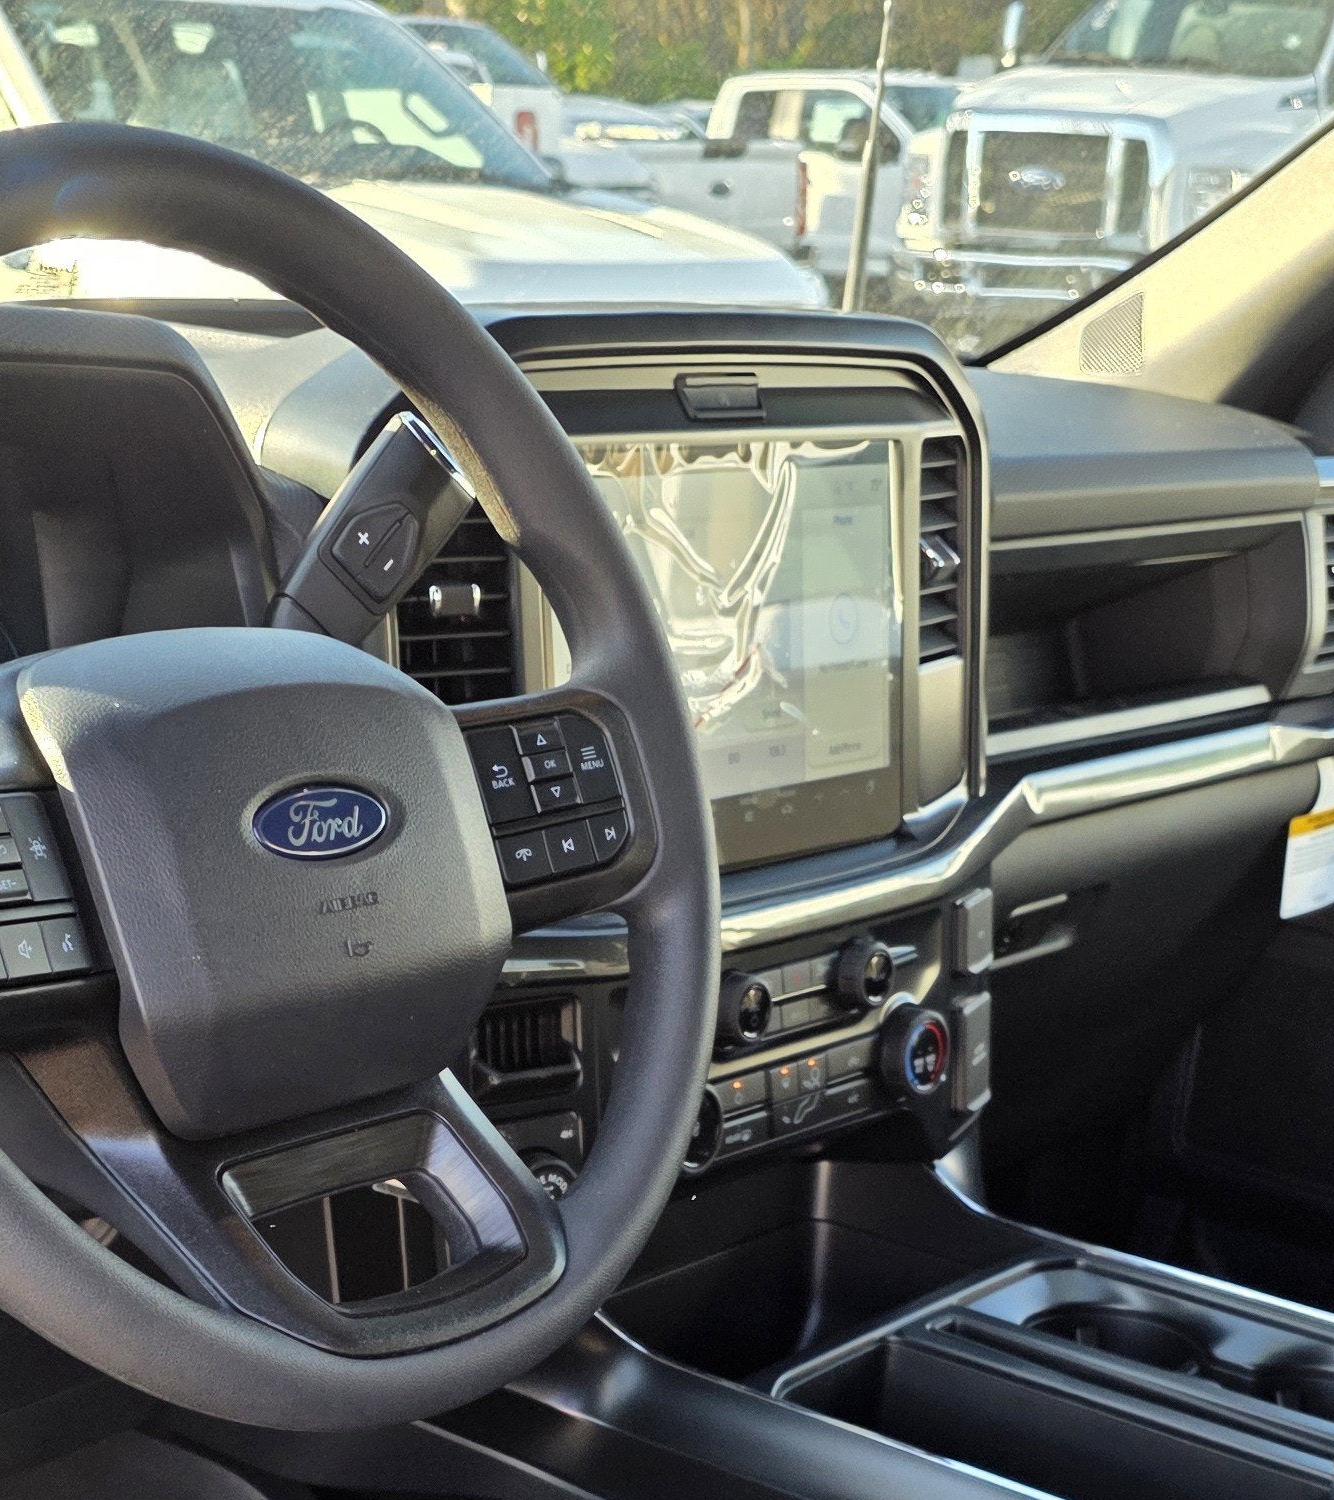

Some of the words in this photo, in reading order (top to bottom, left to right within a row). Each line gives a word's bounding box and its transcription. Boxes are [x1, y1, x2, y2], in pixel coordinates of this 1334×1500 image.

[544, 759, 556, 769] OK
[580, 759, 605, 771] MENU
[491, 777, 516, 790] BACK
[287, 797, 364, 847] Ford
